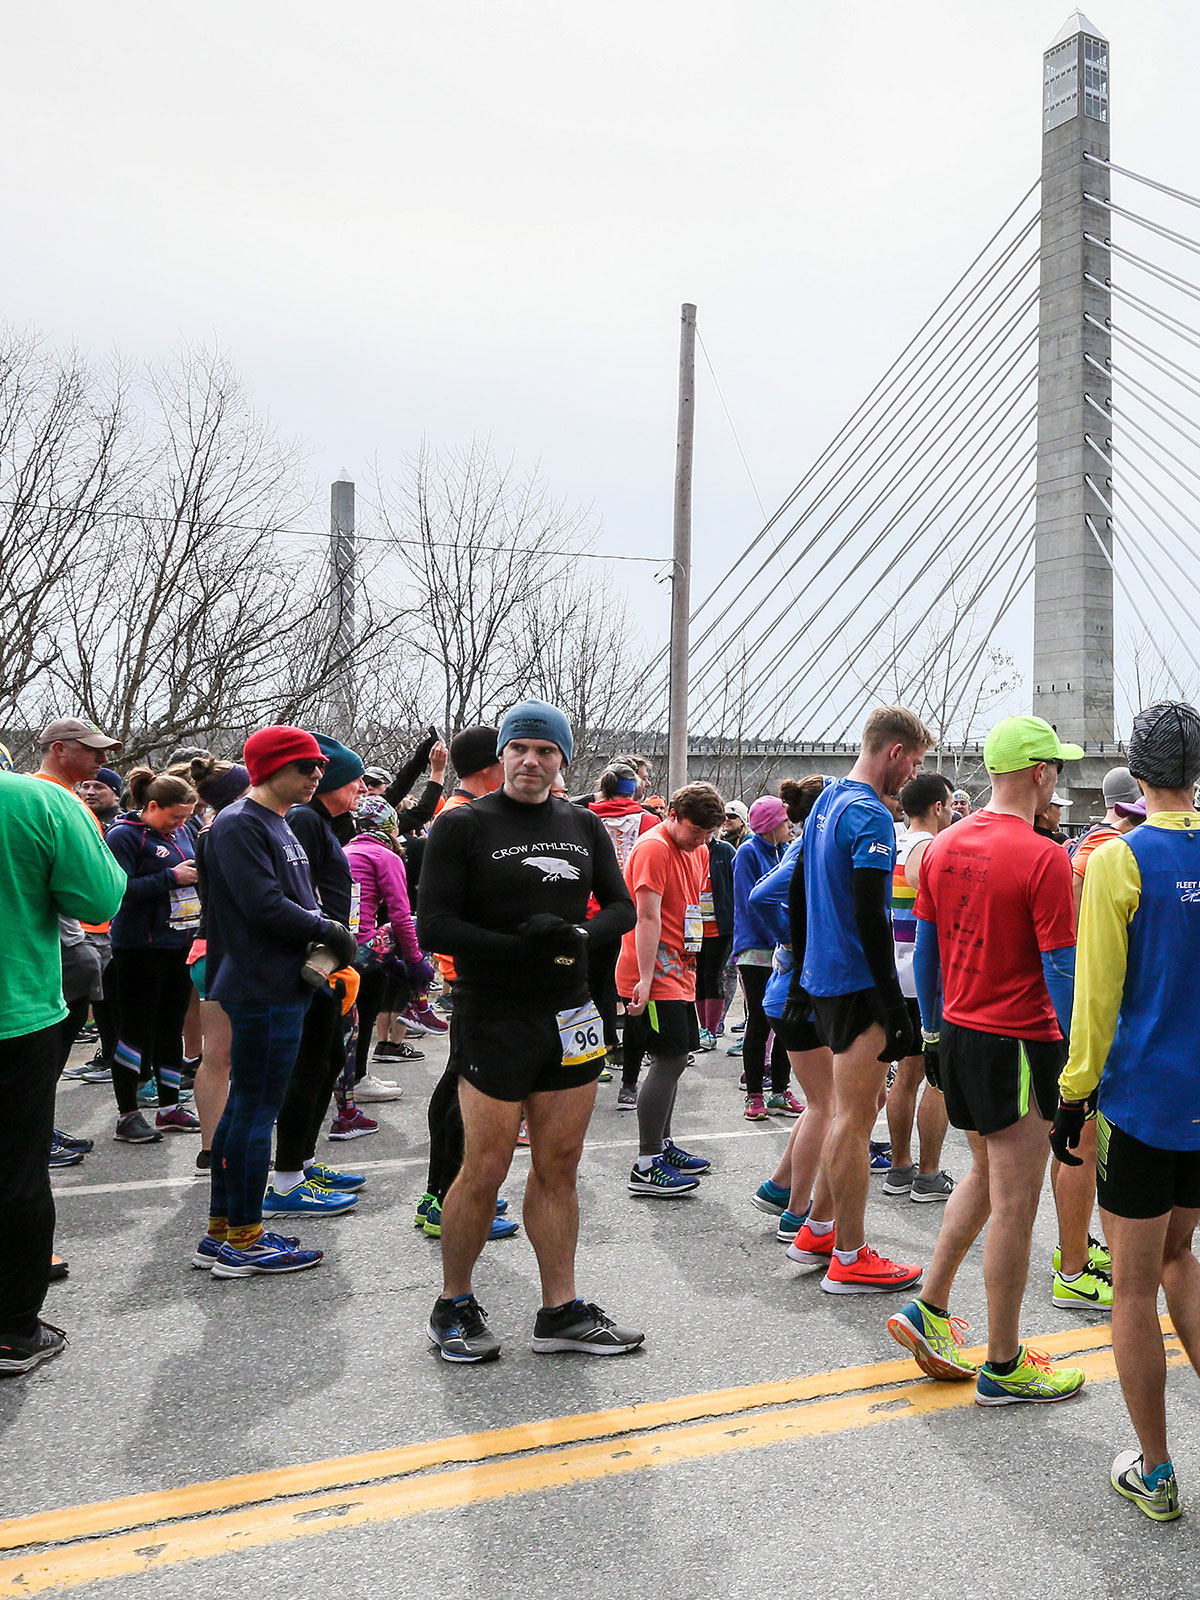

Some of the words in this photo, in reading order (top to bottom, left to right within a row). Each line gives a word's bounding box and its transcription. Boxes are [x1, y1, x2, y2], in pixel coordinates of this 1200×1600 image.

[491, 845, 528, 860] CROW
[531, 842, 590, 857] ATHLETICS
[1176, 881, 1198, 889] FLEET
[575, 1025, 599, 1051] 96
[585, 1051, 599, 1060] Scott
